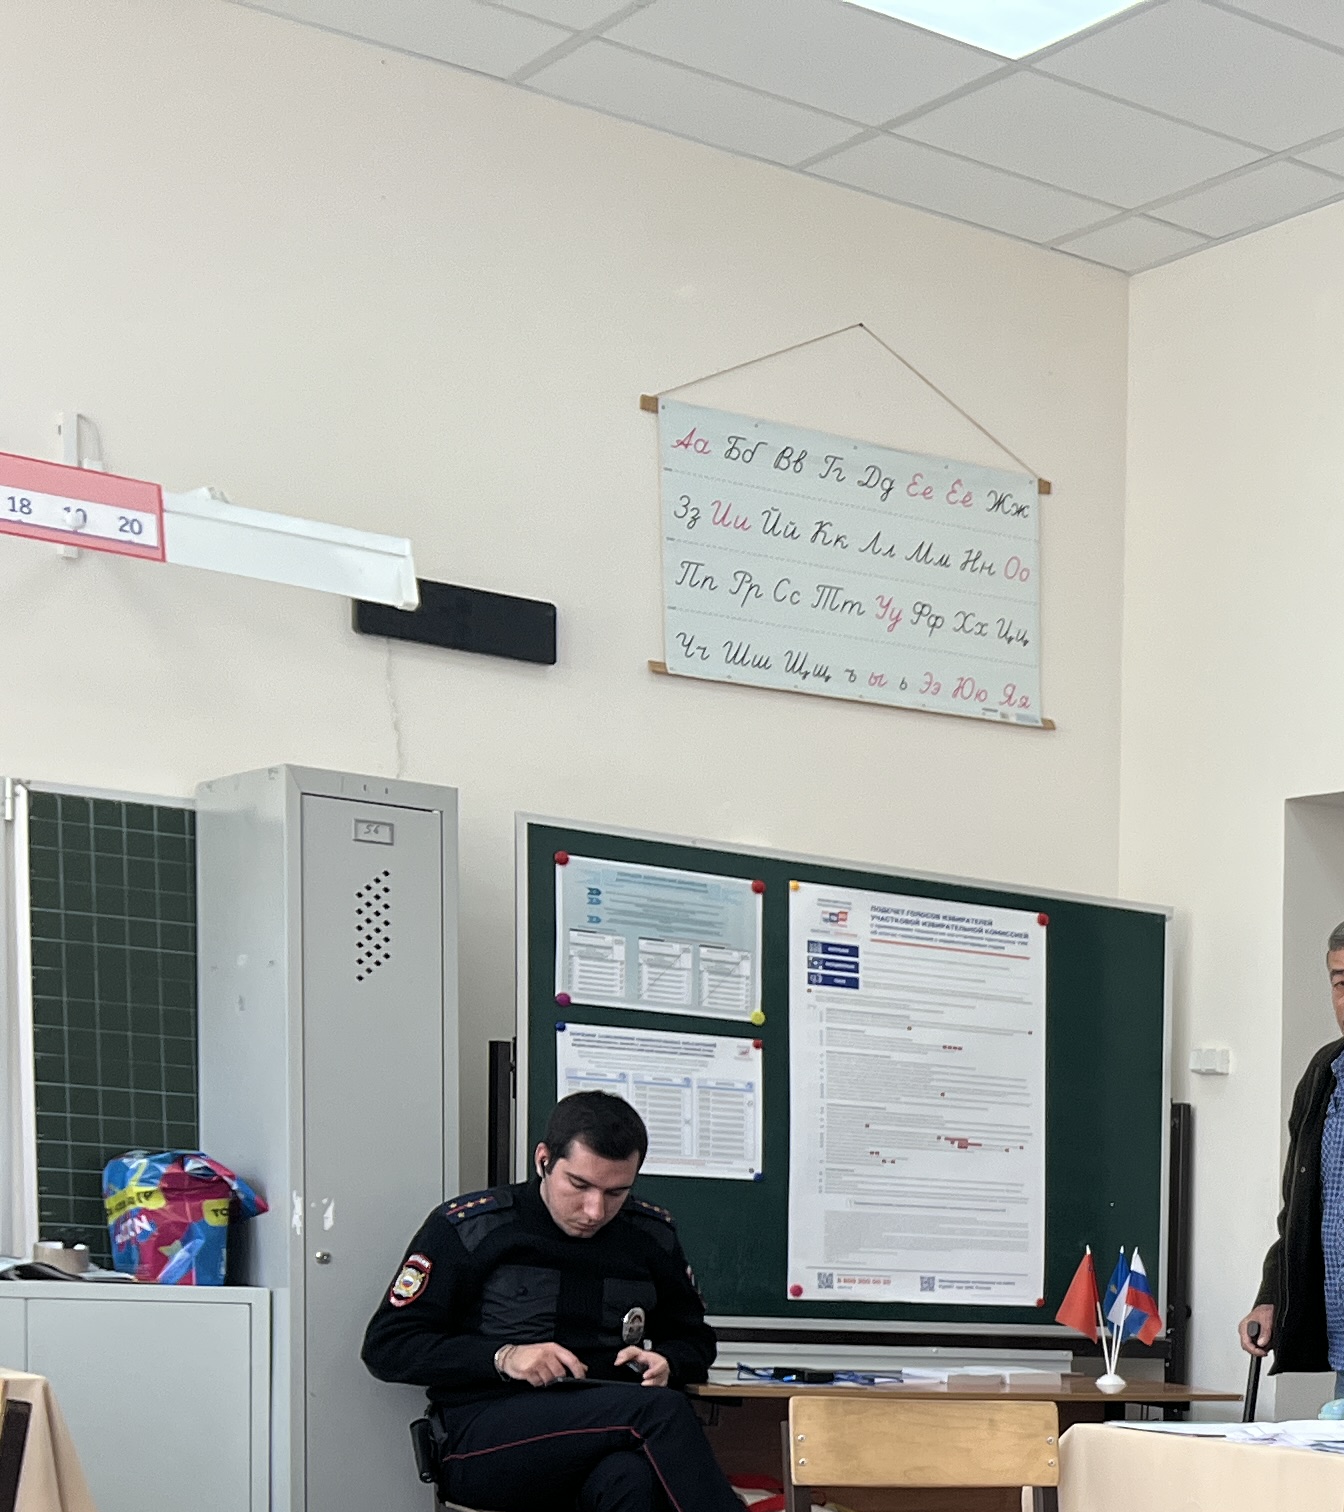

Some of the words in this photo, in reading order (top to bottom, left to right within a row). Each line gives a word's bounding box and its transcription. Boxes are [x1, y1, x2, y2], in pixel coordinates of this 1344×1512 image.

[7, 496, 33, 515] 18
[118, 516, 143, 535] 20
[672, 427, 711, 454] Аа
[724, 435, 766, 464] Бб
[774, 445, 806, 474] Вв
[819, 454, 846, 483] Гг
[858, 465, 895, 501] Дд
[906, 472, 934, 501] Ее
[986, 489, 1029, 520] Жж
[674, 495, 701, 529] Зз
[711, 501, 750, 532] Ии
[762, 506, 801, 540] Йй
[810, 520, 848, 549] Кк
[859, 531, 896, 559] Лл
[905, 542, 951, 569] Мм
[959, 549, 996, 577] Нн
[1004, 556, 1031, 582] Оо
[675, 560, 718, 591] Пп
[729, 570, 764, 606] Рр
[774, 579, 801, 606] Сс
[811, 584, 866, 616] Тт
[876, 595, 902, 632] Уу
[911, 602, 944, 637] Фф
[954, 611, 988, 637] Хх
[997, 618, 1029, 647] Цц
[675, 632, 710, 661] Чч
[723, 640, 772, 670] Шш
[785, 650, 832, 682] Щщ
[845, 668, 857, 683] ъ
[868, 672, 887, 687] ы
[900, 677, 908, 691] ь
[919, 672, 942, 695] Ээ
[952, 677, 987, 702] Юю
[999, 687, 1031, 709] Яя
